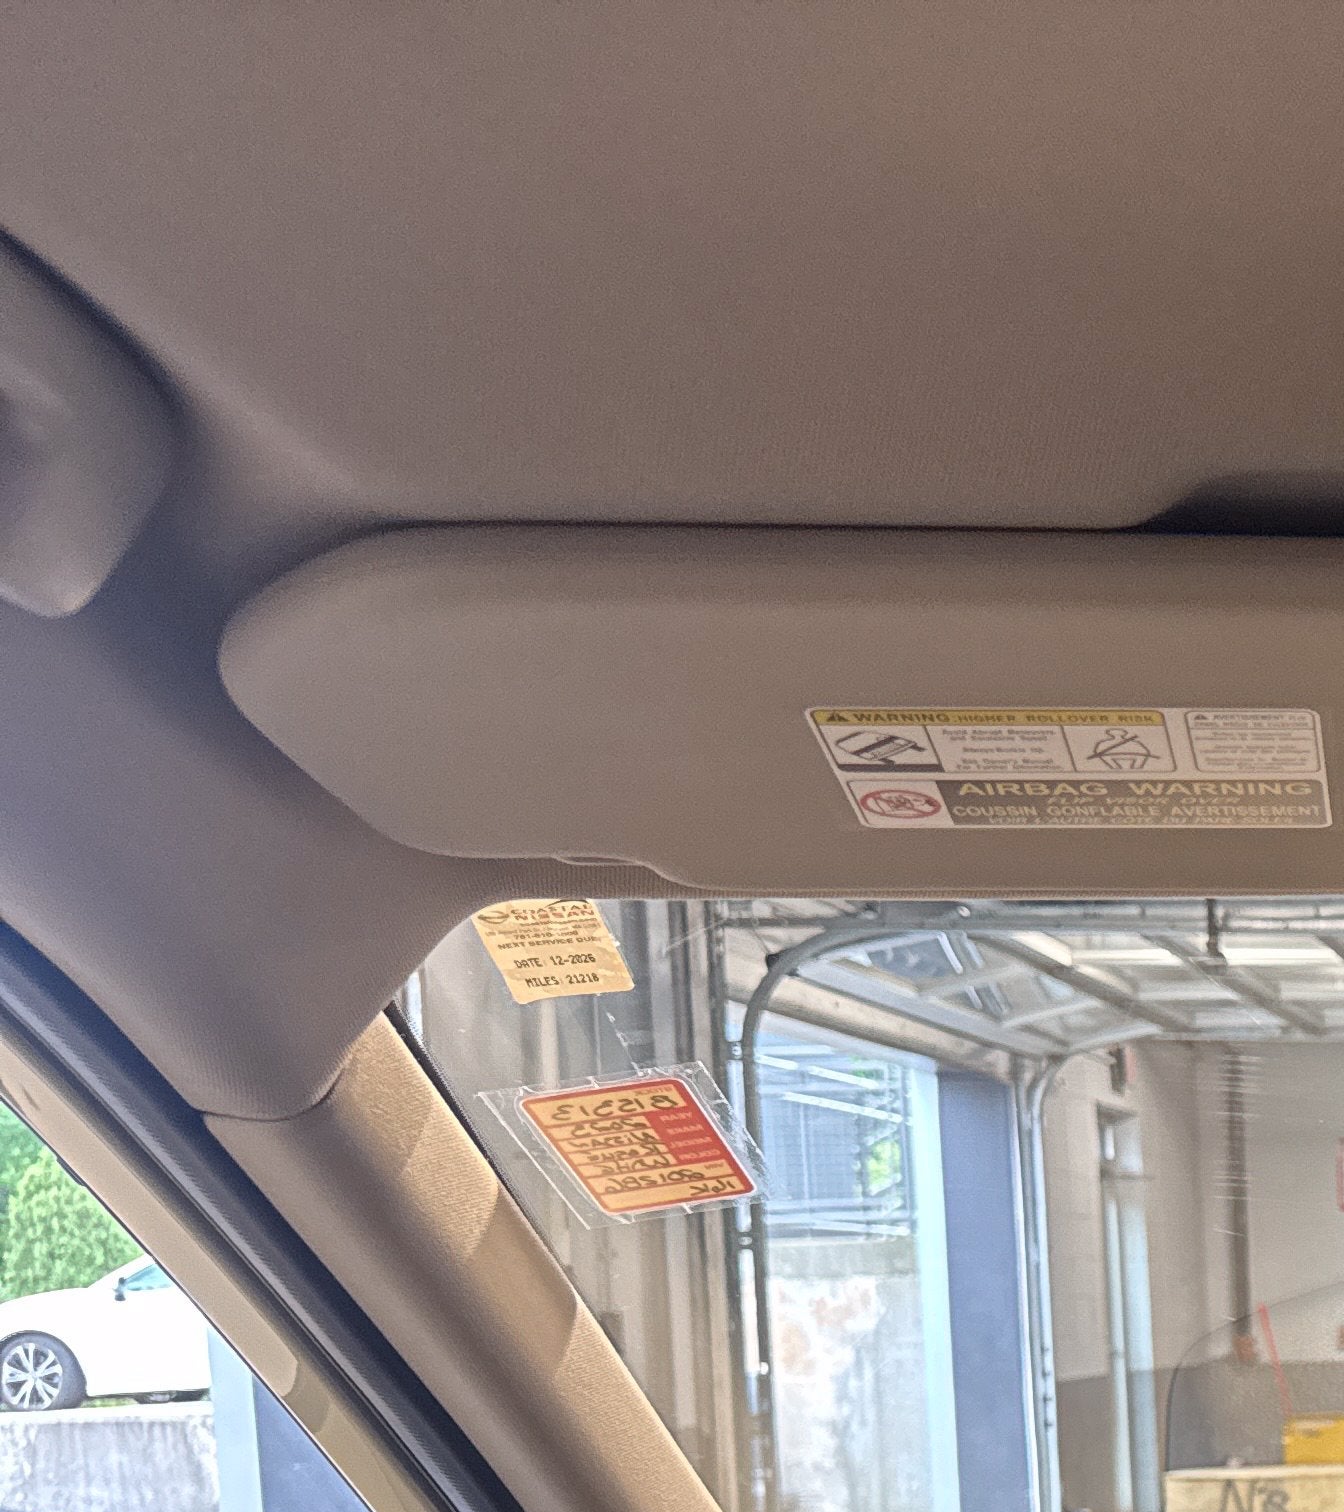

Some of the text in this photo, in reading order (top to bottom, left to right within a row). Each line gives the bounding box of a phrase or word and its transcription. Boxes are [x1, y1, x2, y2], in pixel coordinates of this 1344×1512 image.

[1027, 715, 1109, 723] ROLLOVER
[1119, 715, 1156, 723] RISK
[959, 782, 1312, 795] AIRBAG WARNING
[953, 806, 1321, 817] COUSSIN GONFLABLE AVERTISSEMENT
[515, 910, 595, 921] NISSAN
[497, 942, 526, 950] NEXT
[529, 938, 574, 946] SERVICE
[550, 953, 597, 966] 12-2026
